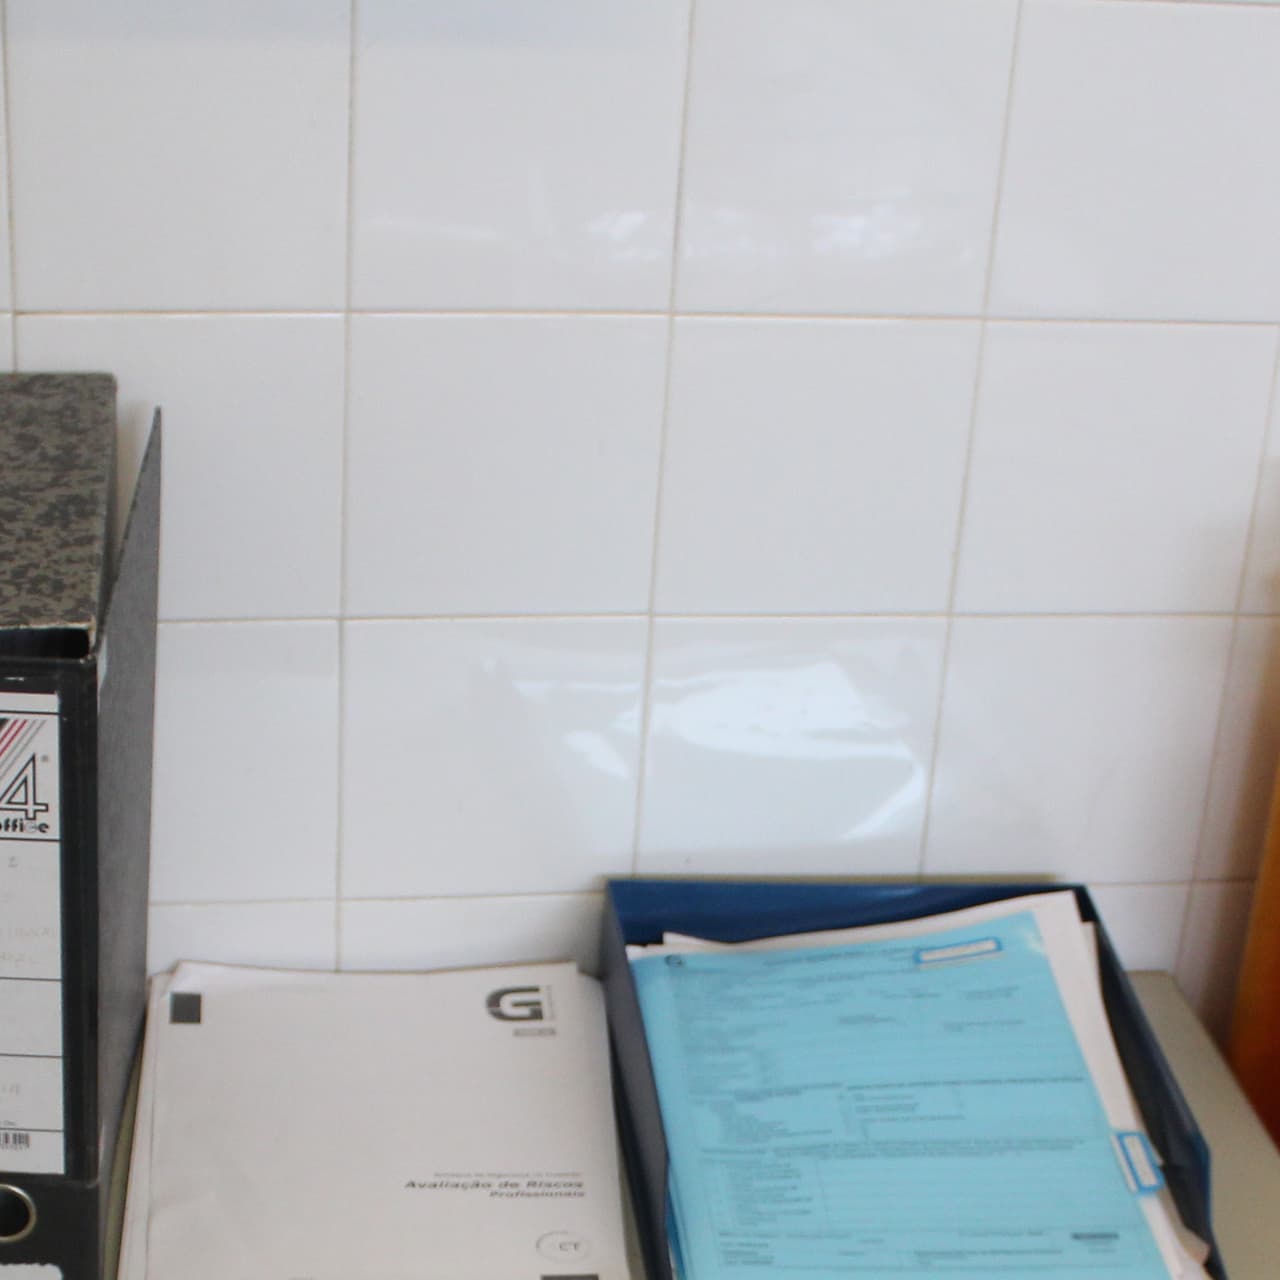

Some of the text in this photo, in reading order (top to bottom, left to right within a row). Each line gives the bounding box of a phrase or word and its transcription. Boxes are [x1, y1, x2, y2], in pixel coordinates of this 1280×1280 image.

[404, 1179, 584, 1191] Avaliação de Riscos
[489, 1190, 586, 1198] Profissionais
